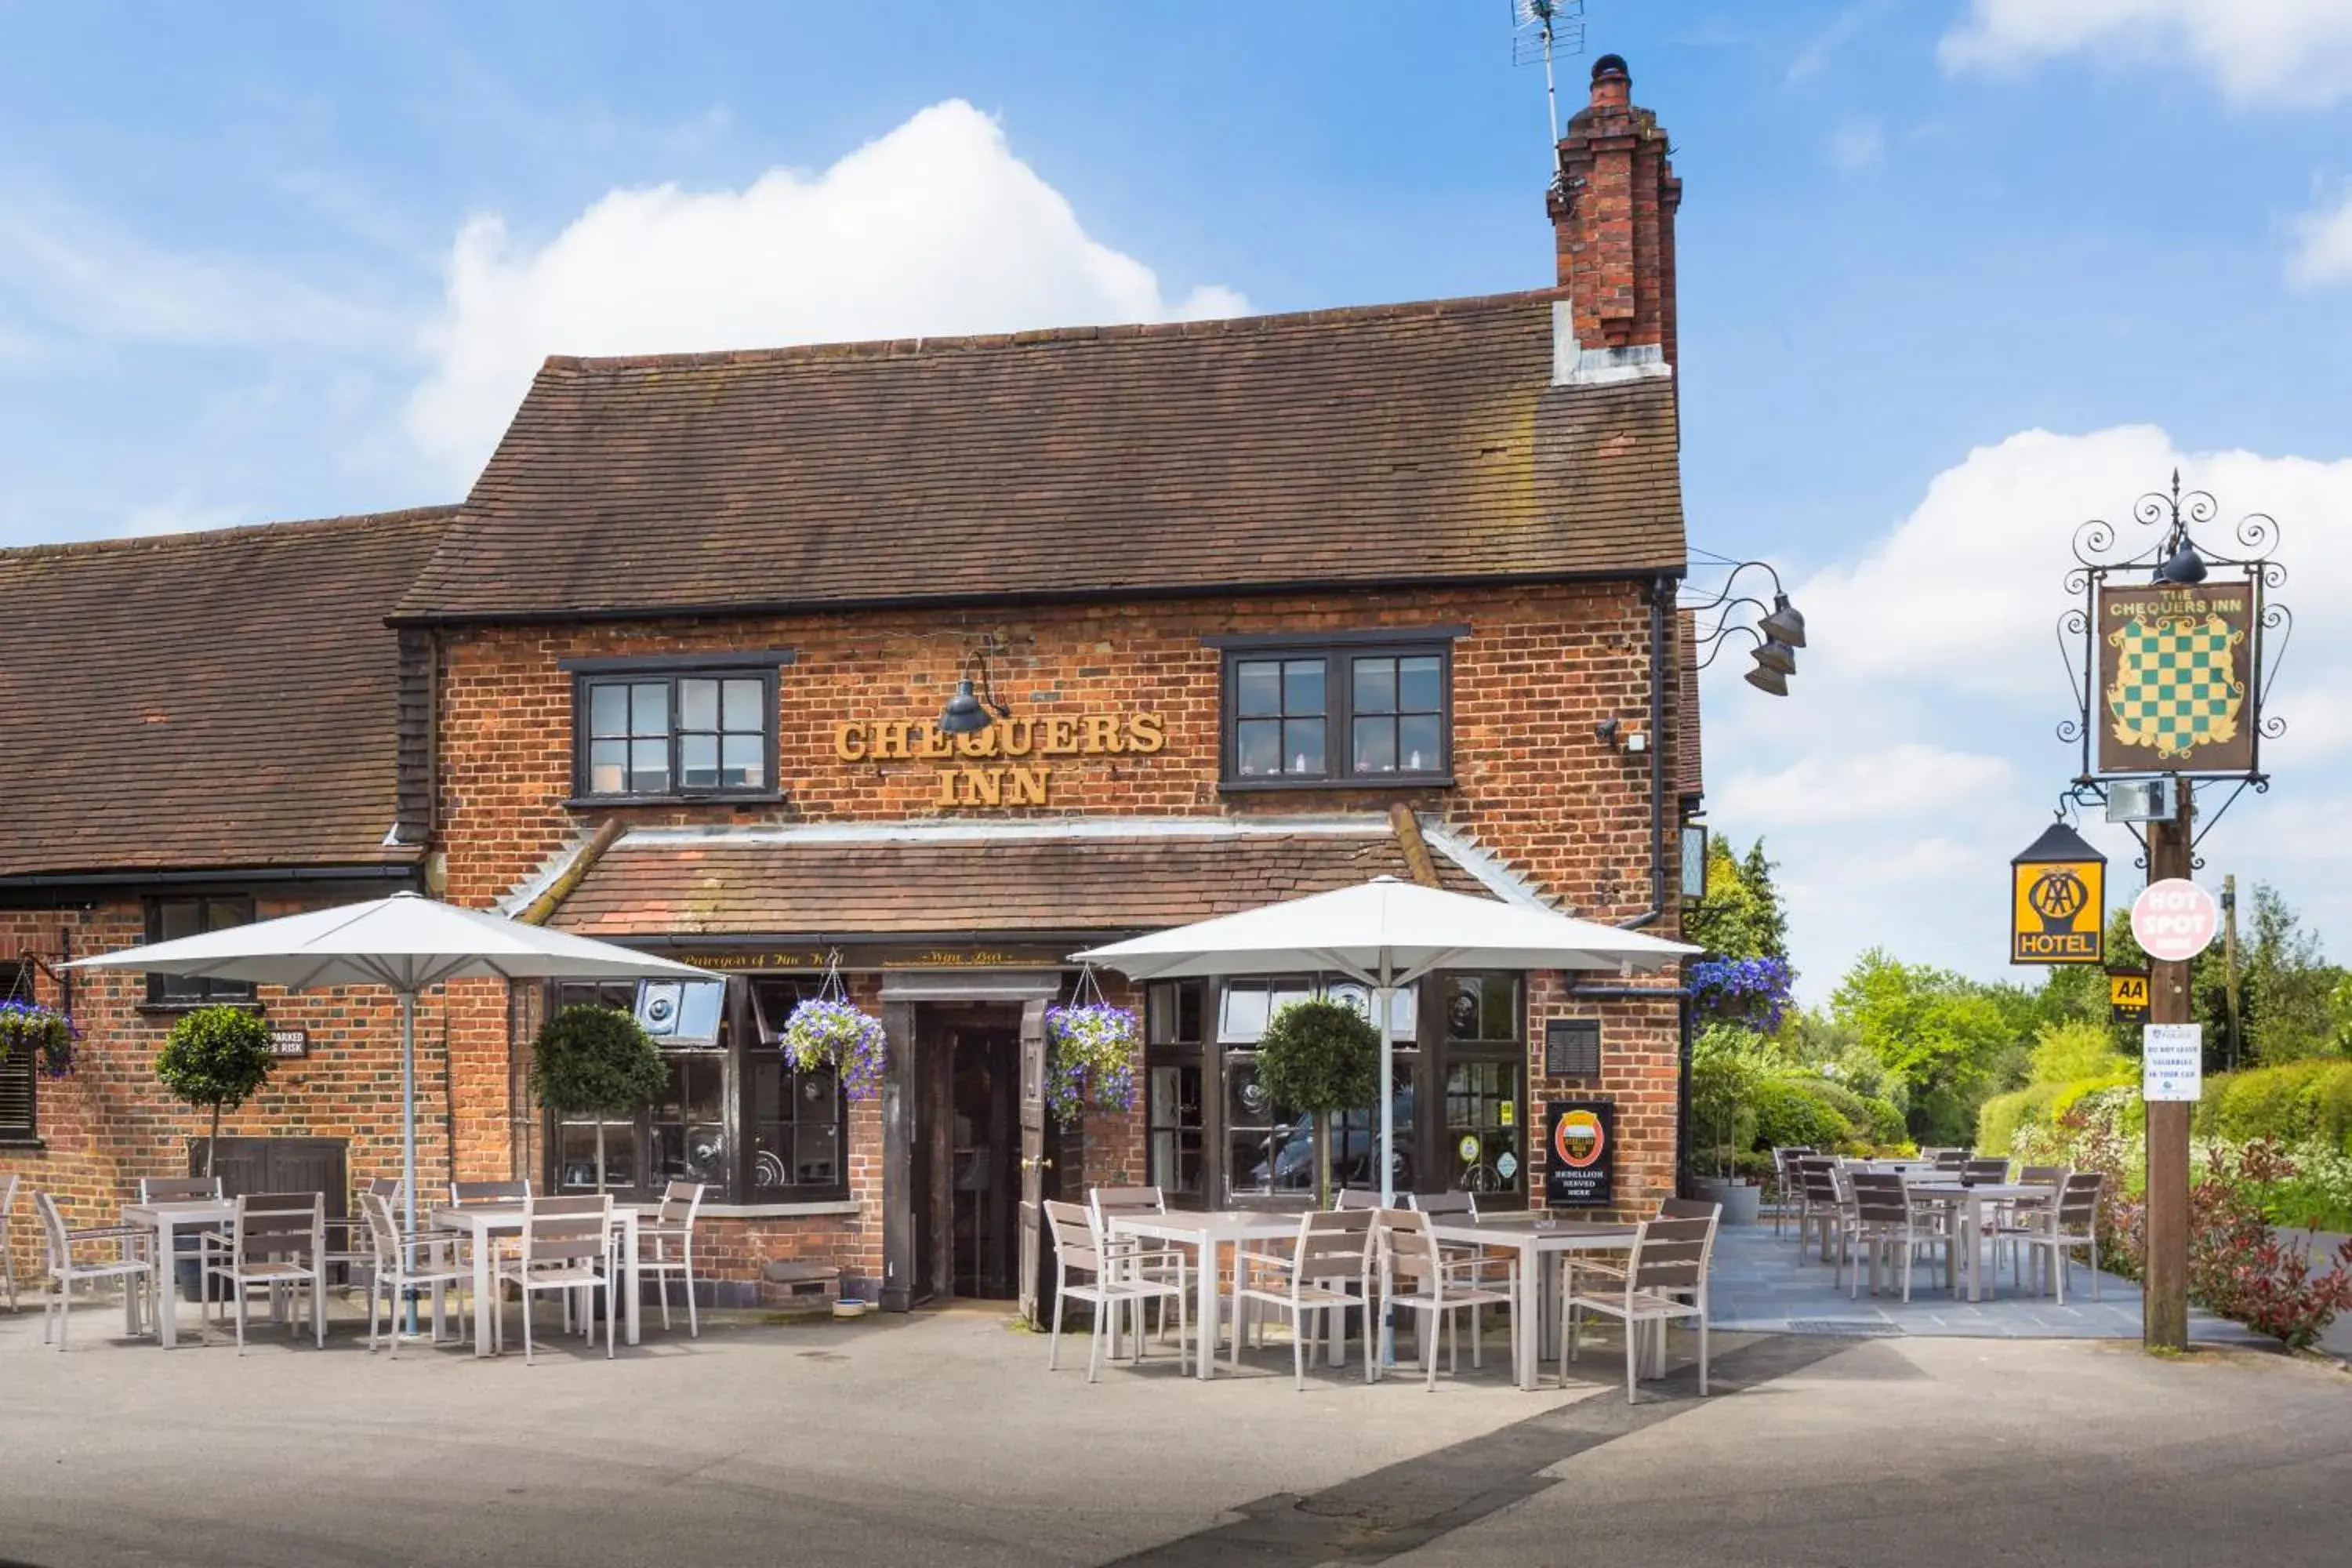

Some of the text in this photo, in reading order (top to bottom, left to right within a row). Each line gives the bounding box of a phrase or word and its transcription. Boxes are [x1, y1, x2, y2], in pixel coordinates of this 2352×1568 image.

[2158, 590, 2192, 601] THE
[2110, 598, 2242, 616] CHEQUERS INN
[835, 713, 1164, 760] CHEQUERS
[937, 768, 1051, 807] INN
[2148, 891, 2200, 911] HOT
[2142, 914, 2208, 935] SPOT
[2021, 935, 2093, 953] HOTEL
[752, 953, 765, 967] of
[2118, 980, 2143, 998] AA
[270, 1032, 303, 1042] PARKED
[281, 1043, 302, 1053] RISK
[1555, 1171, 1604, 1179] REBELLION
